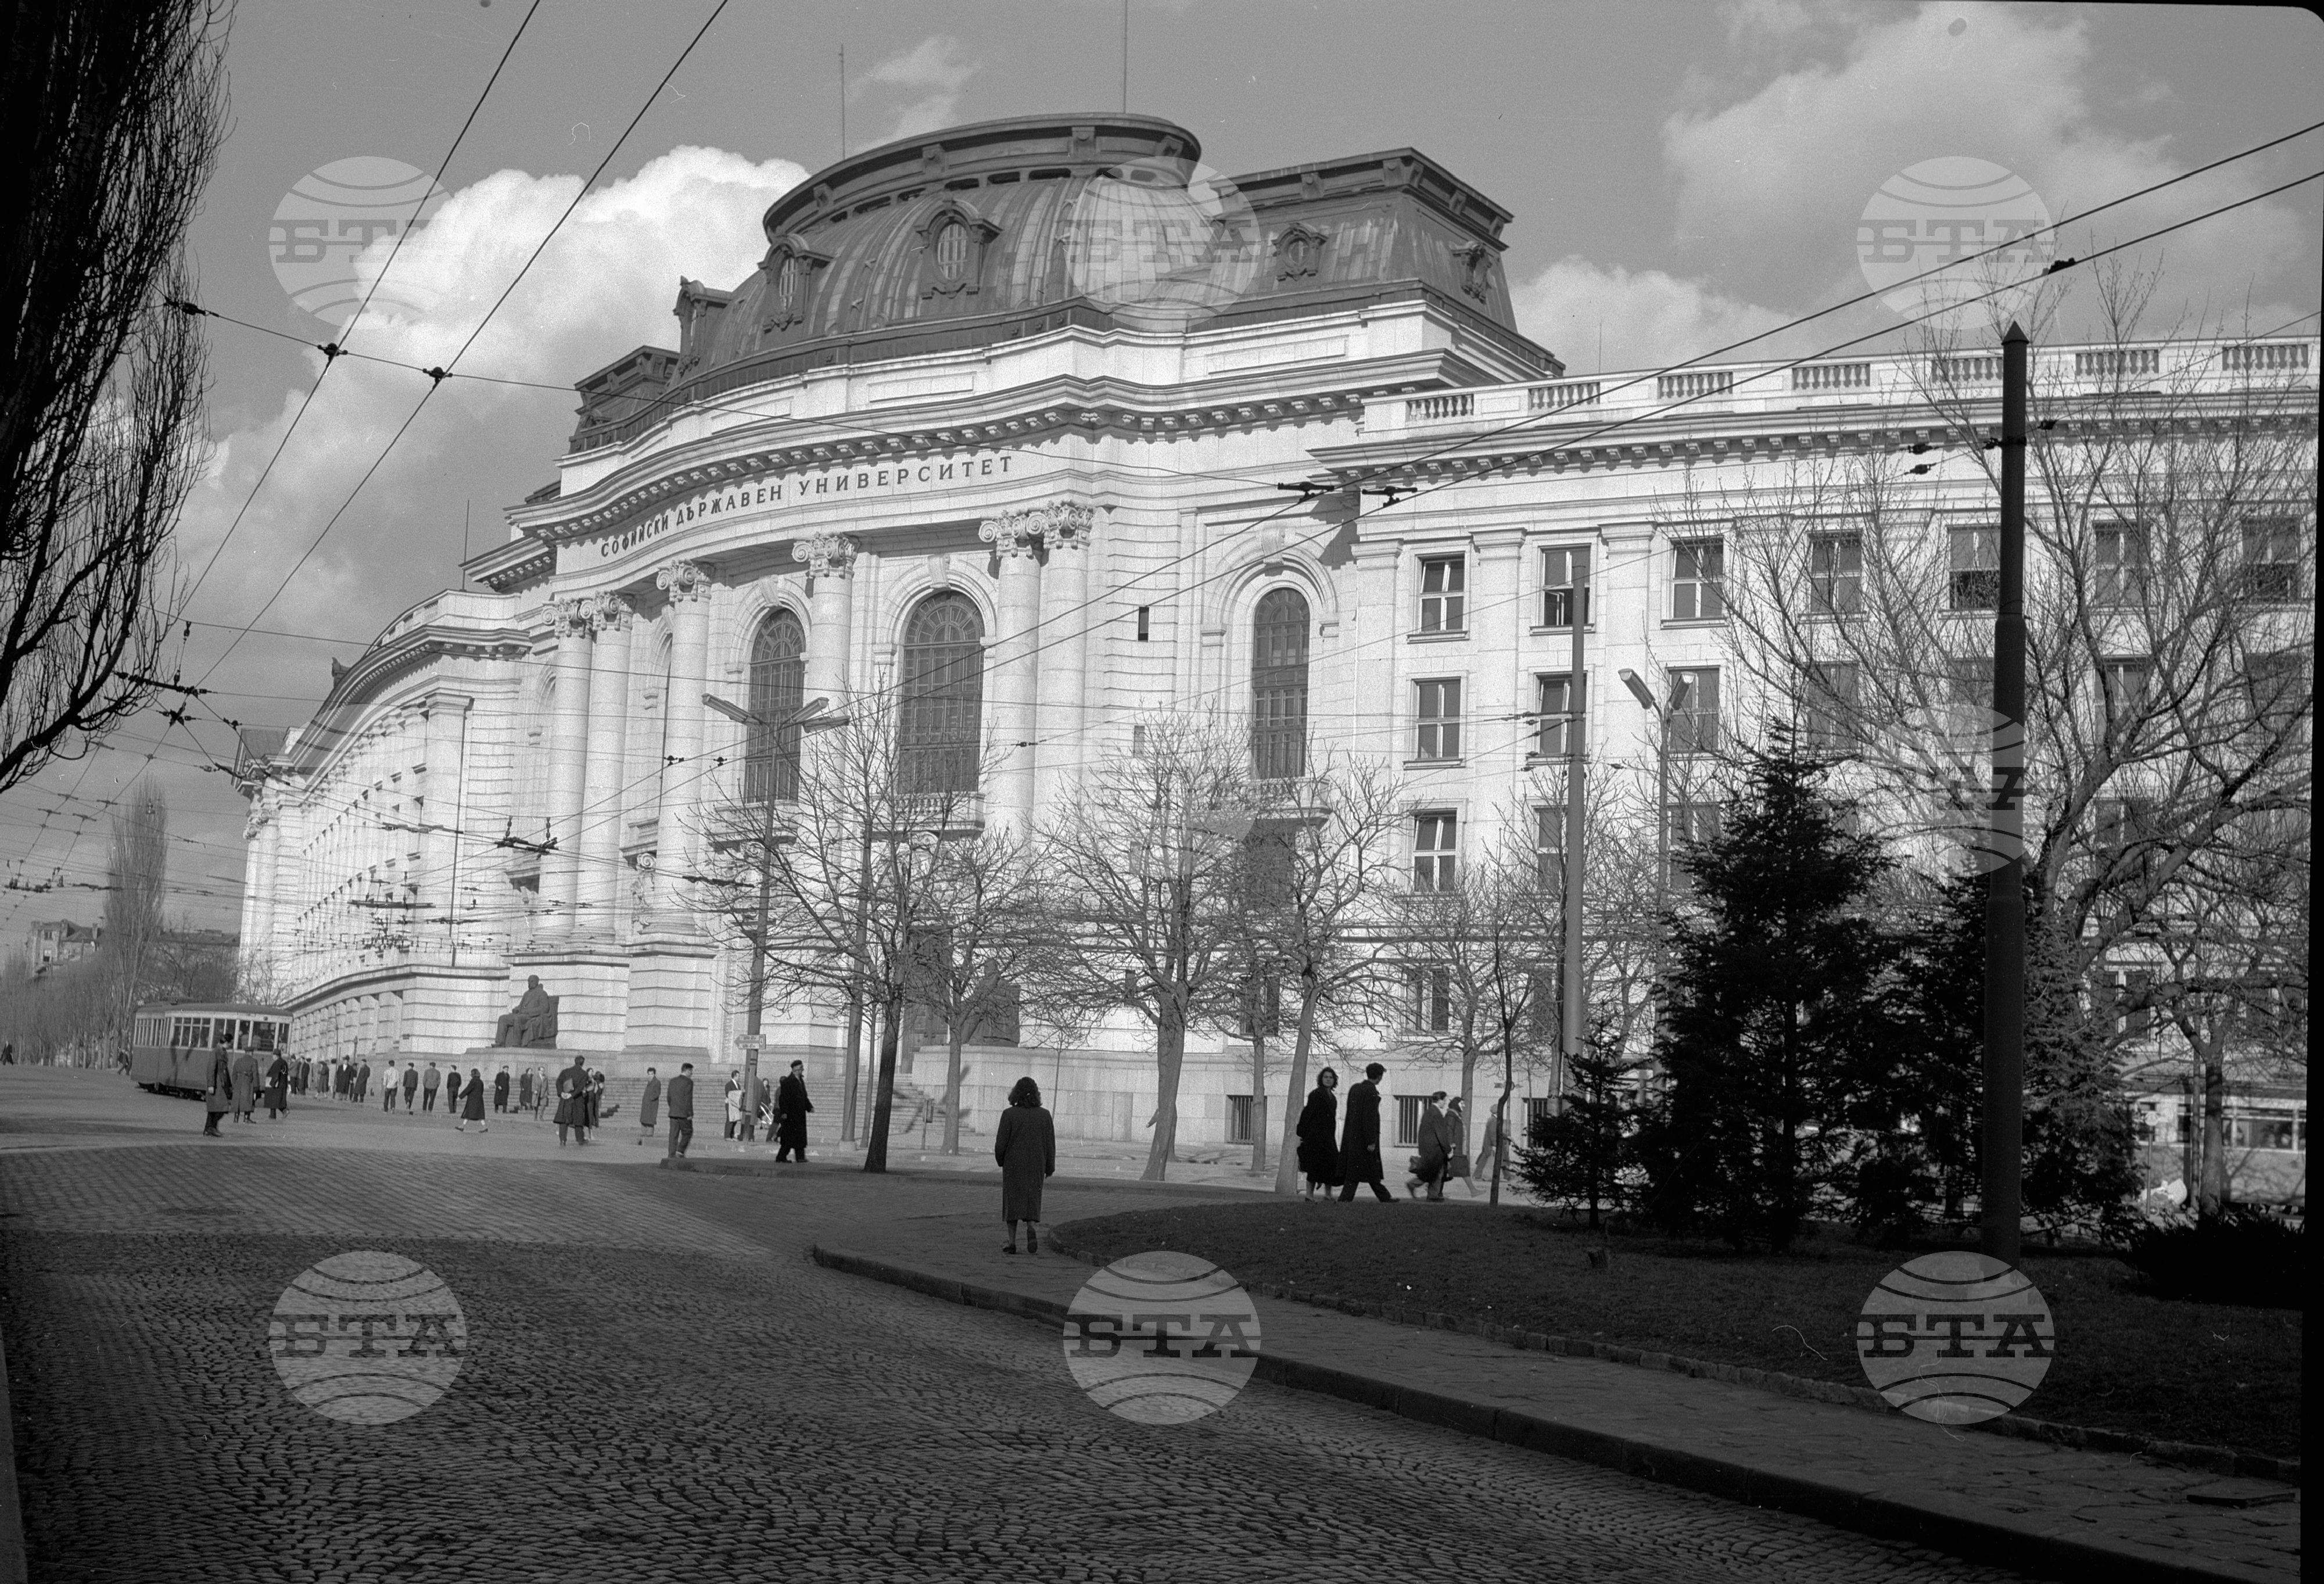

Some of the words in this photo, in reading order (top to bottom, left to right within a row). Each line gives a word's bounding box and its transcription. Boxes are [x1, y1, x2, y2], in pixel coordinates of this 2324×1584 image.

[601, 515, 669, 557] СОФИЙСКИ
[676, 485, 782, 526] ДЪРЖАВЕН
[798, 456, 1012, 496] УНИВЕРСИТЕТ
